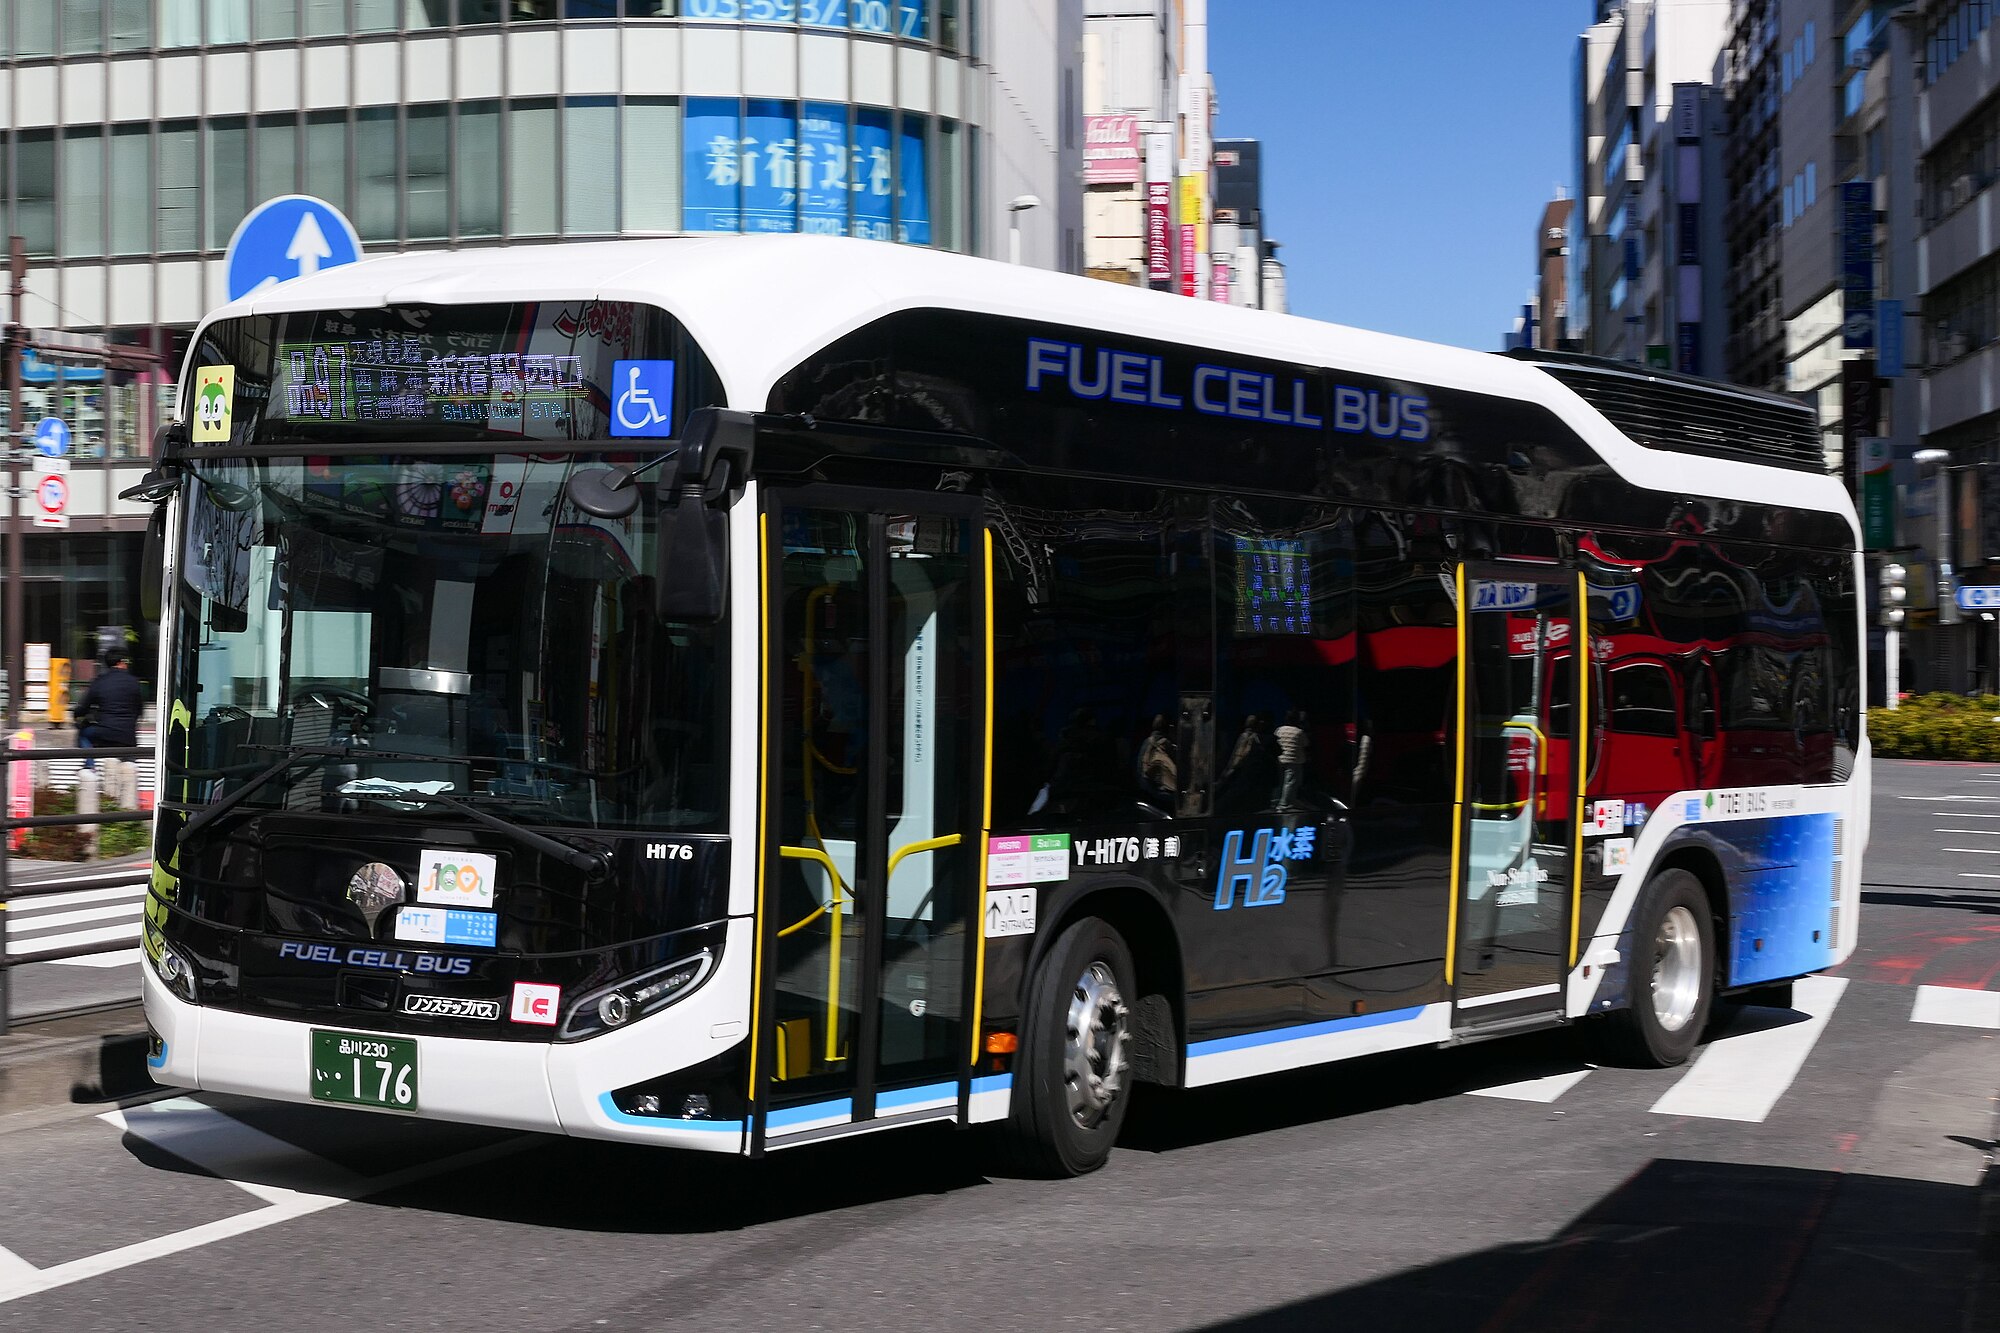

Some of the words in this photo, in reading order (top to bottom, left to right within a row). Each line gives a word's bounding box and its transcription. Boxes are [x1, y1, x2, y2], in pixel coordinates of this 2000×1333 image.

[426, 352, 584, 396] 新宿駅西口
[1025, 337, 1183, 409] FUEL
[1192, 363, 1323, 429] CELL
[1333, 384, 1430, 442] BUS
[442, 402, 522, 420] SHINJUKU
[529, 401, 572, 419] STA.
[646, 843, 693, 860] H176
[1074, 836, 1140, 866] Y-H176
[1269, 826, 1317, 861] 水素
[401, 912, 431, 927] HTT
[279, 942, 342, 964] FUEL
[346, 949, 408, 970] CELL
[415, 955, 473, 976] BUS
[409, 996, 494, 1018] ノンステップバス
